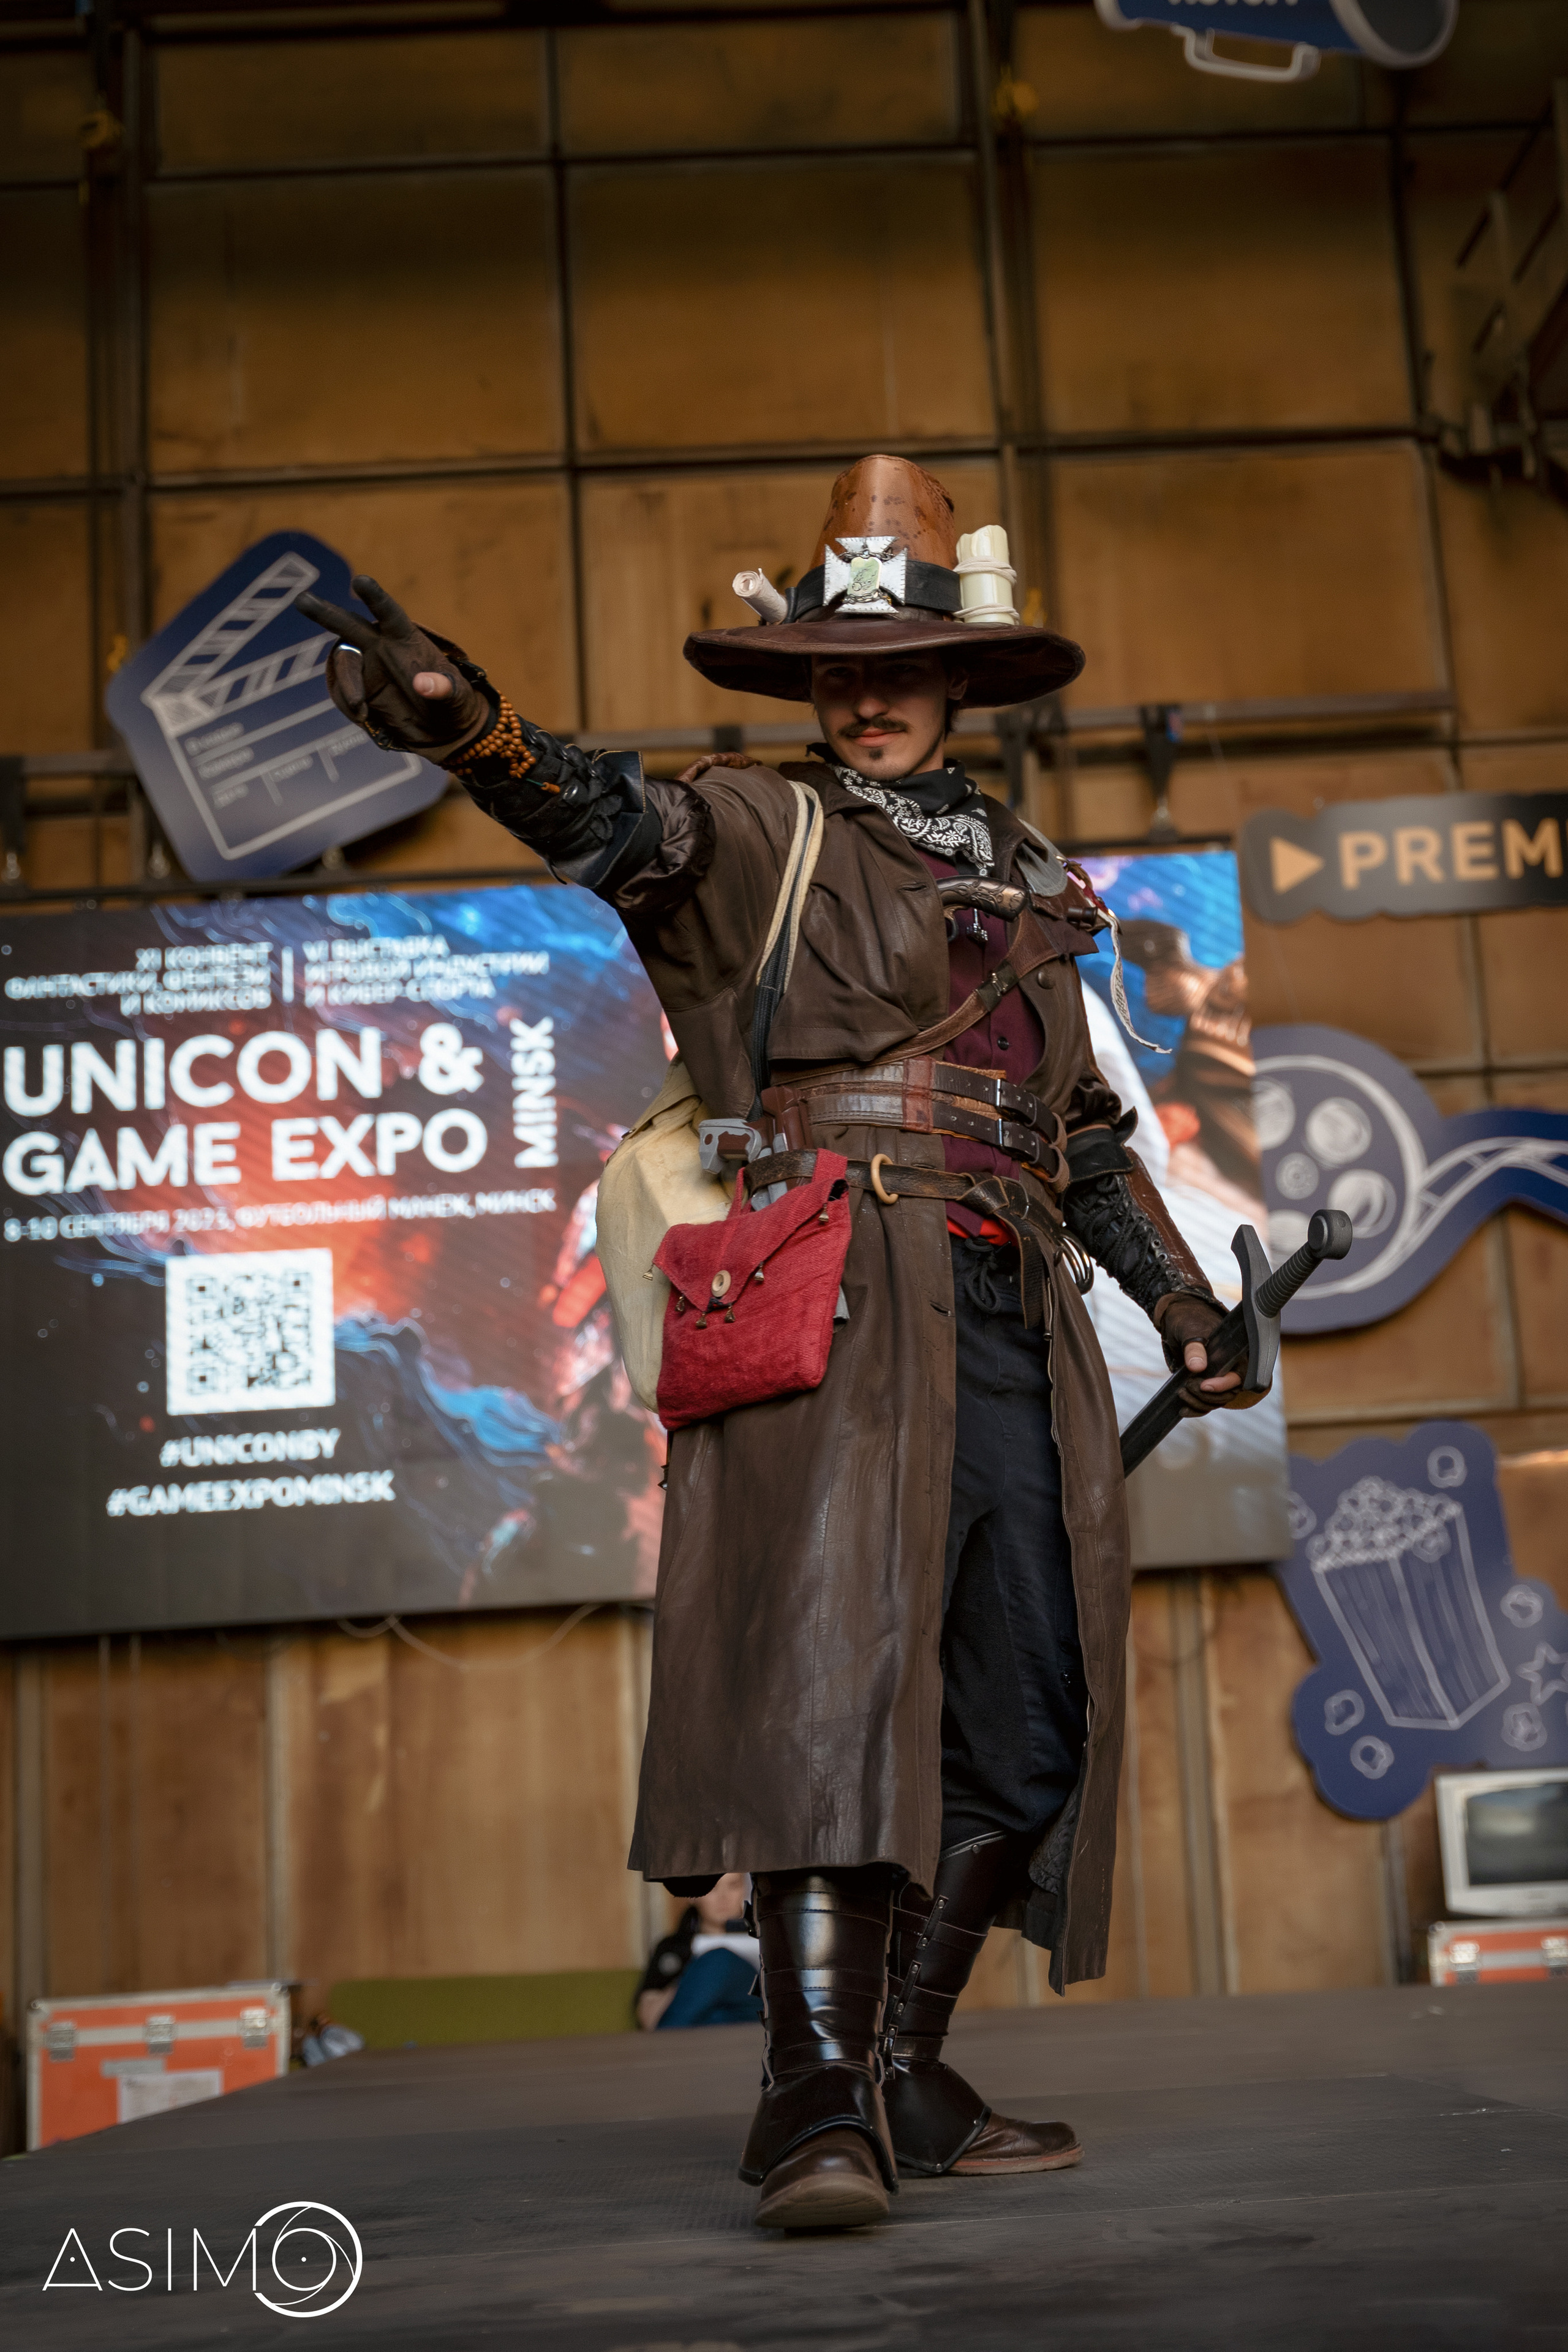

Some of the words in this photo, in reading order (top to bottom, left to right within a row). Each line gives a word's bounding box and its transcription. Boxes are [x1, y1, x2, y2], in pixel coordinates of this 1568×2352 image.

[1338, 817, 1568, 891] PREM
[3, 1025, 383, 1117] UNICON
[418, 1022, 484, 1095] &
[509, 1016, 559, 1169] MINSK
[2, 1121, 242, 1196] GAME
[271, 1107, 489, 1182] EXPO
[159, 1427, 341, 1467] #UNICONBY
[105, 1470, 397, 1517] #GAMEEXPOMINSK
